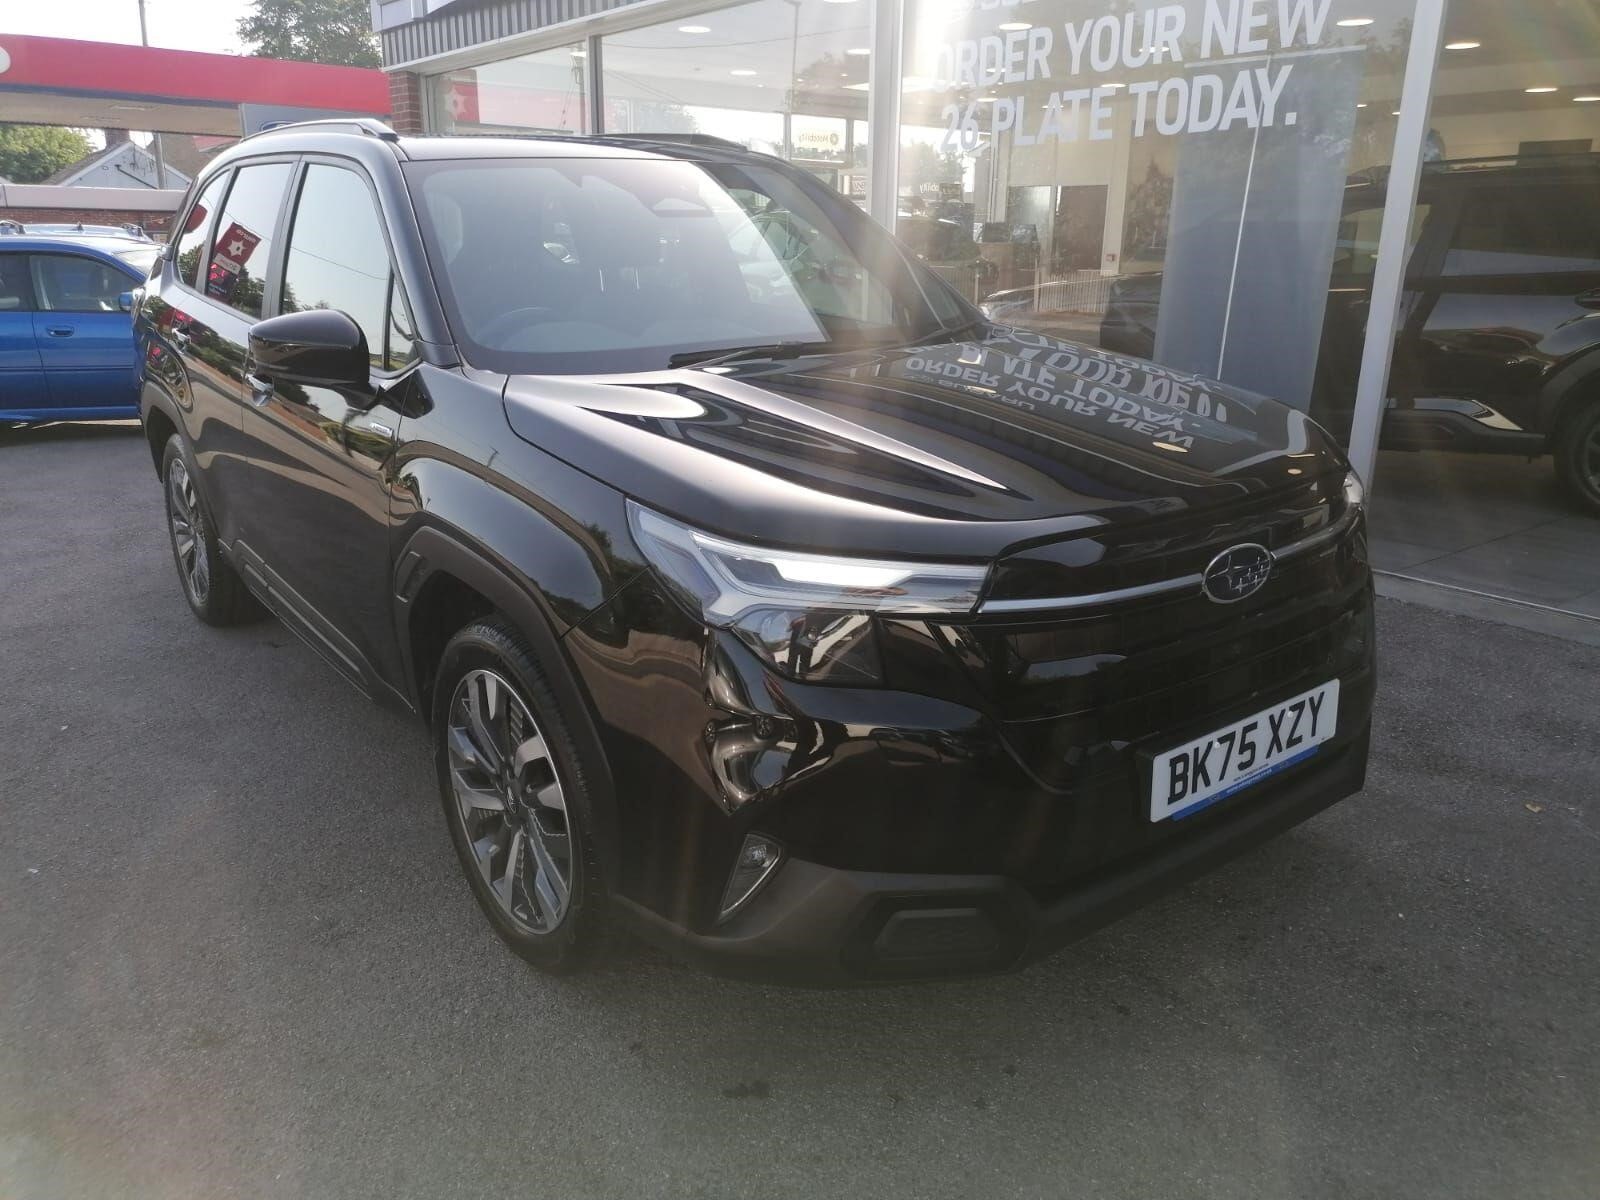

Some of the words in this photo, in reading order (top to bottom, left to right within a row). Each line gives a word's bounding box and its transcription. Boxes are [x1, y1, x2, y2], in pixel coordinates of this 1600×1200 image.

[934, 27, 1053, 92] ORDER
[1064, 5, 1186, 75] YOUR
[1200, 0, 1332, 59] NEW
[940, 100, 980, 153] 26
[991, 87, 1117, 147] PLATE
[1132, 65, 1298, 137] TODAY.
[1168, 721, 1258, 805] BK75
[1265, 691, 1325, 759] XZY
